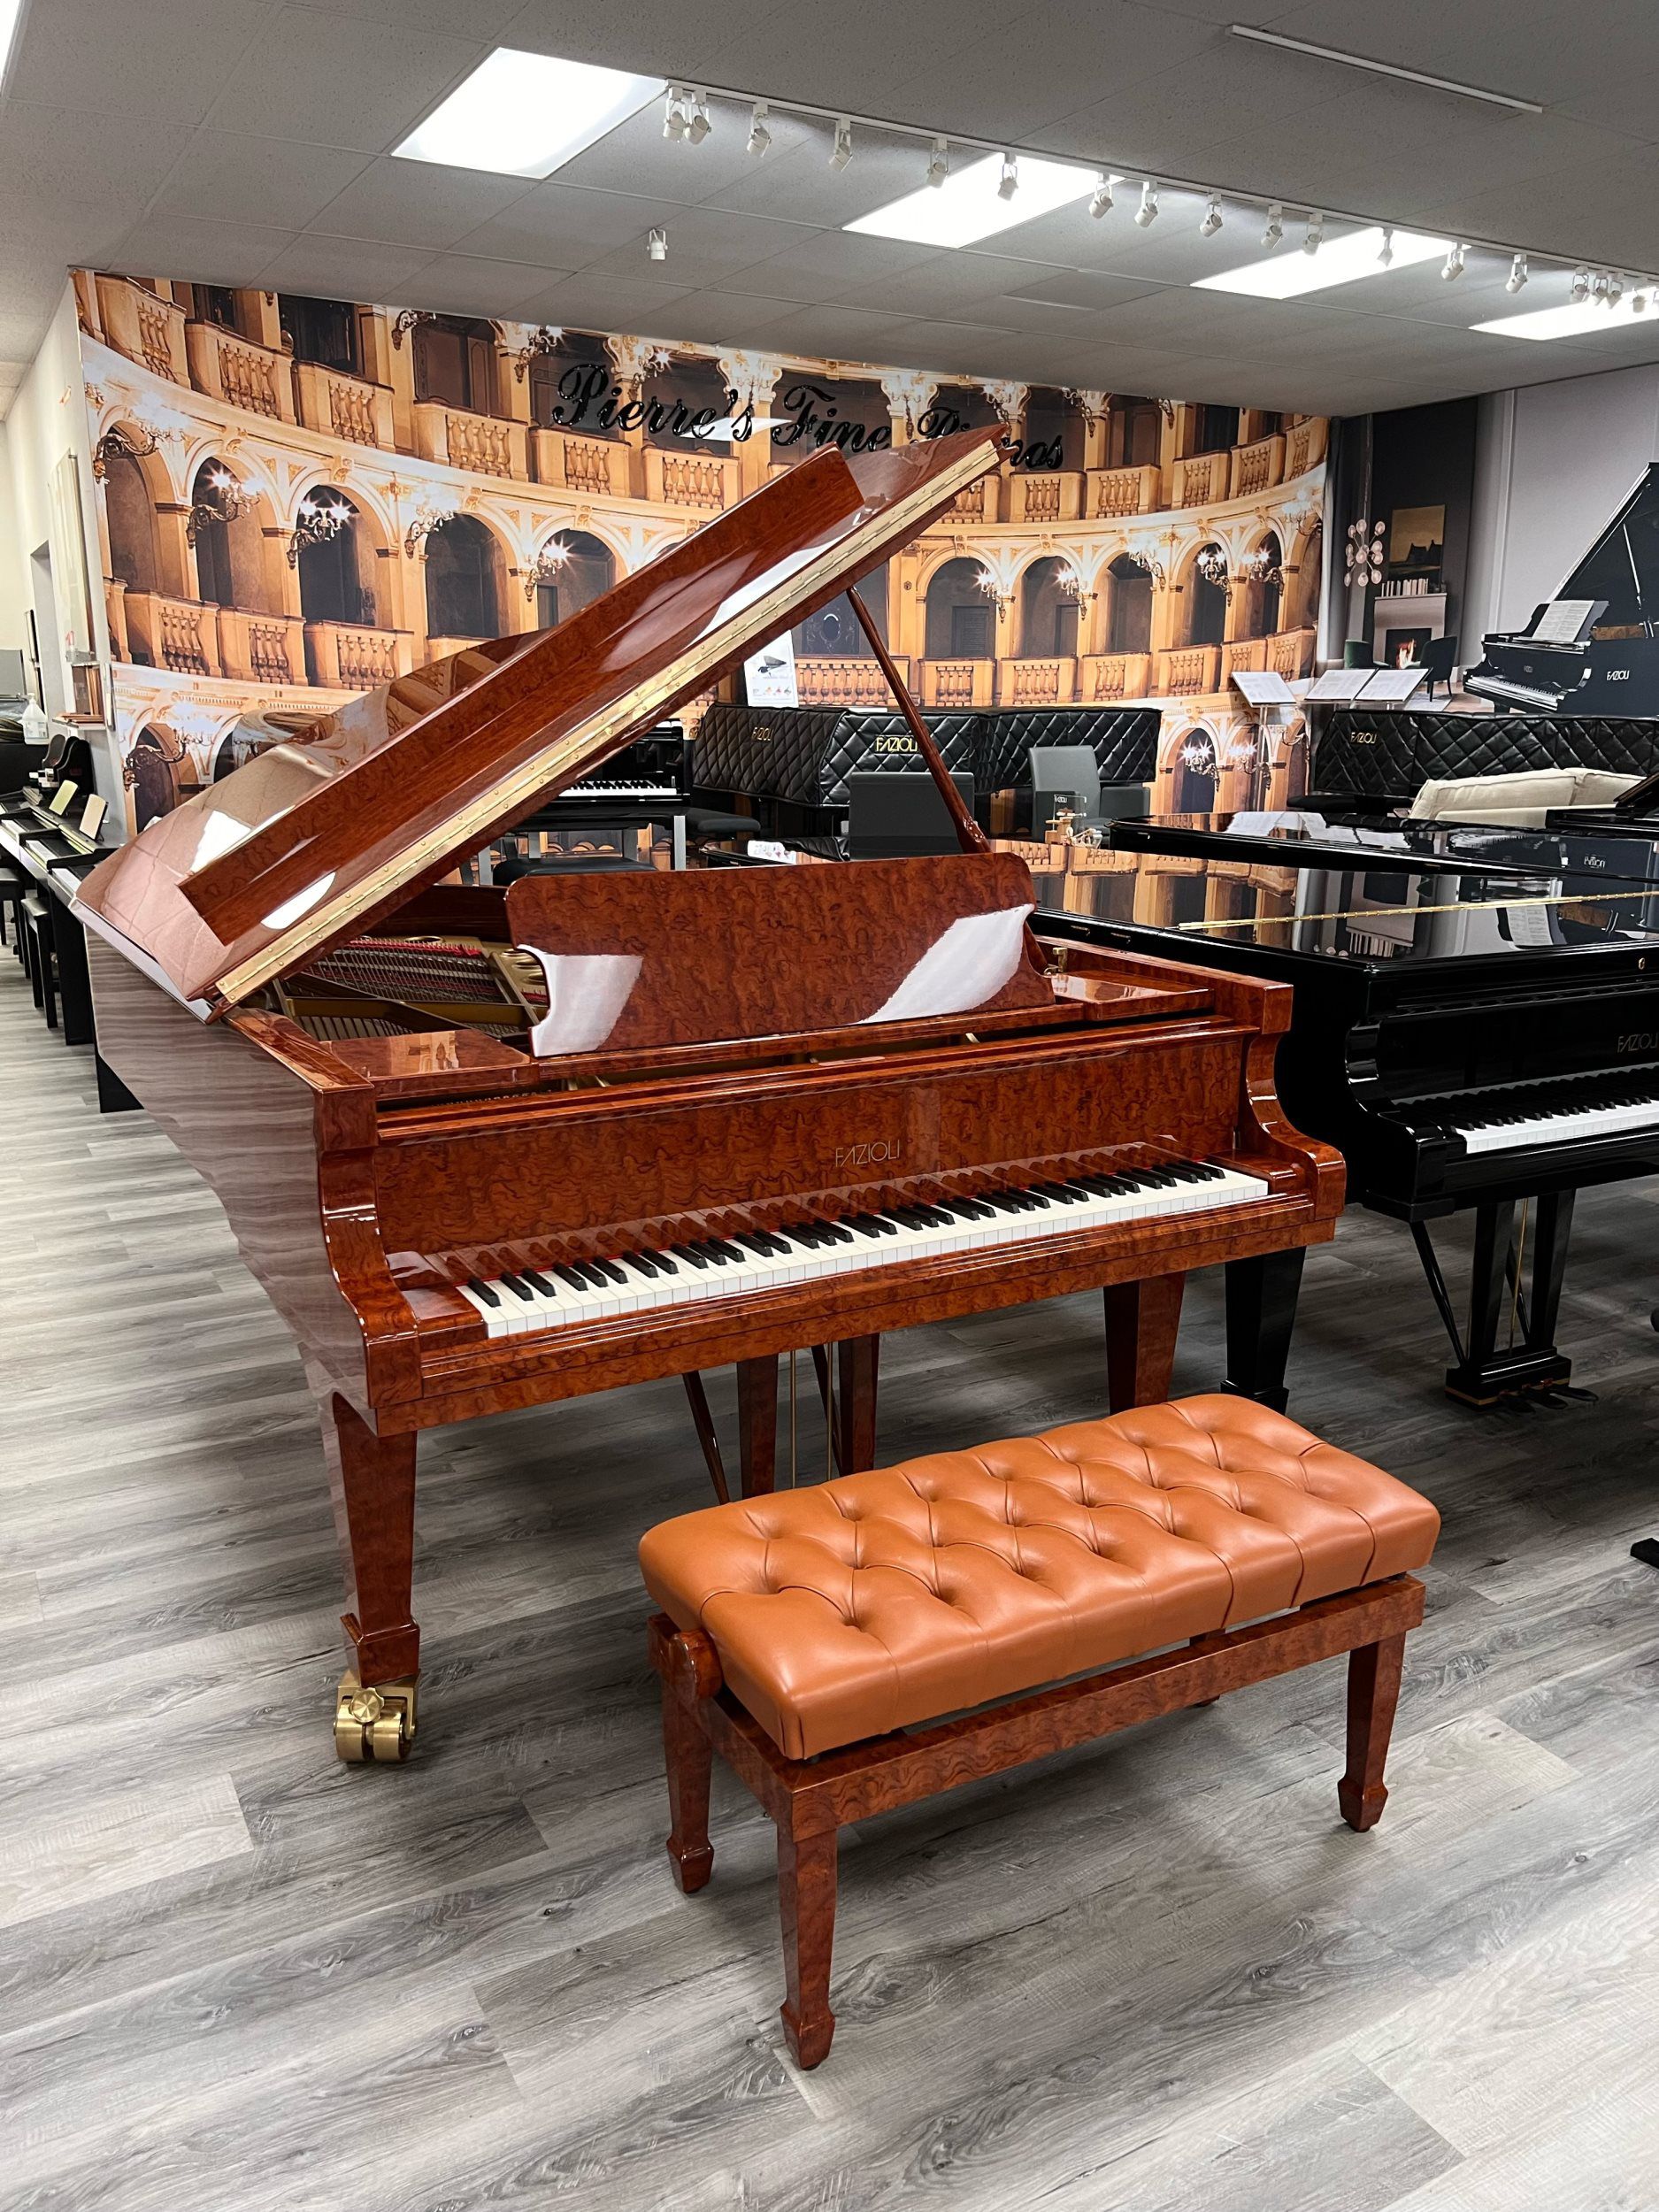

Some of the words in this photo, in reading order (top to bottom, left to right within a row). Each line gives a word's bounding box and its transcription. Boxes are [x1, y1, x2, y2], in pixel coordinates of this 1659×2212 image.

[552, 364, 754, 442] Pierre's
[772, 384, 892, 452] Fine
[910, 406, 1064, 470] Pnos
[835, 1139, 900, 1168] FAZIOLI
